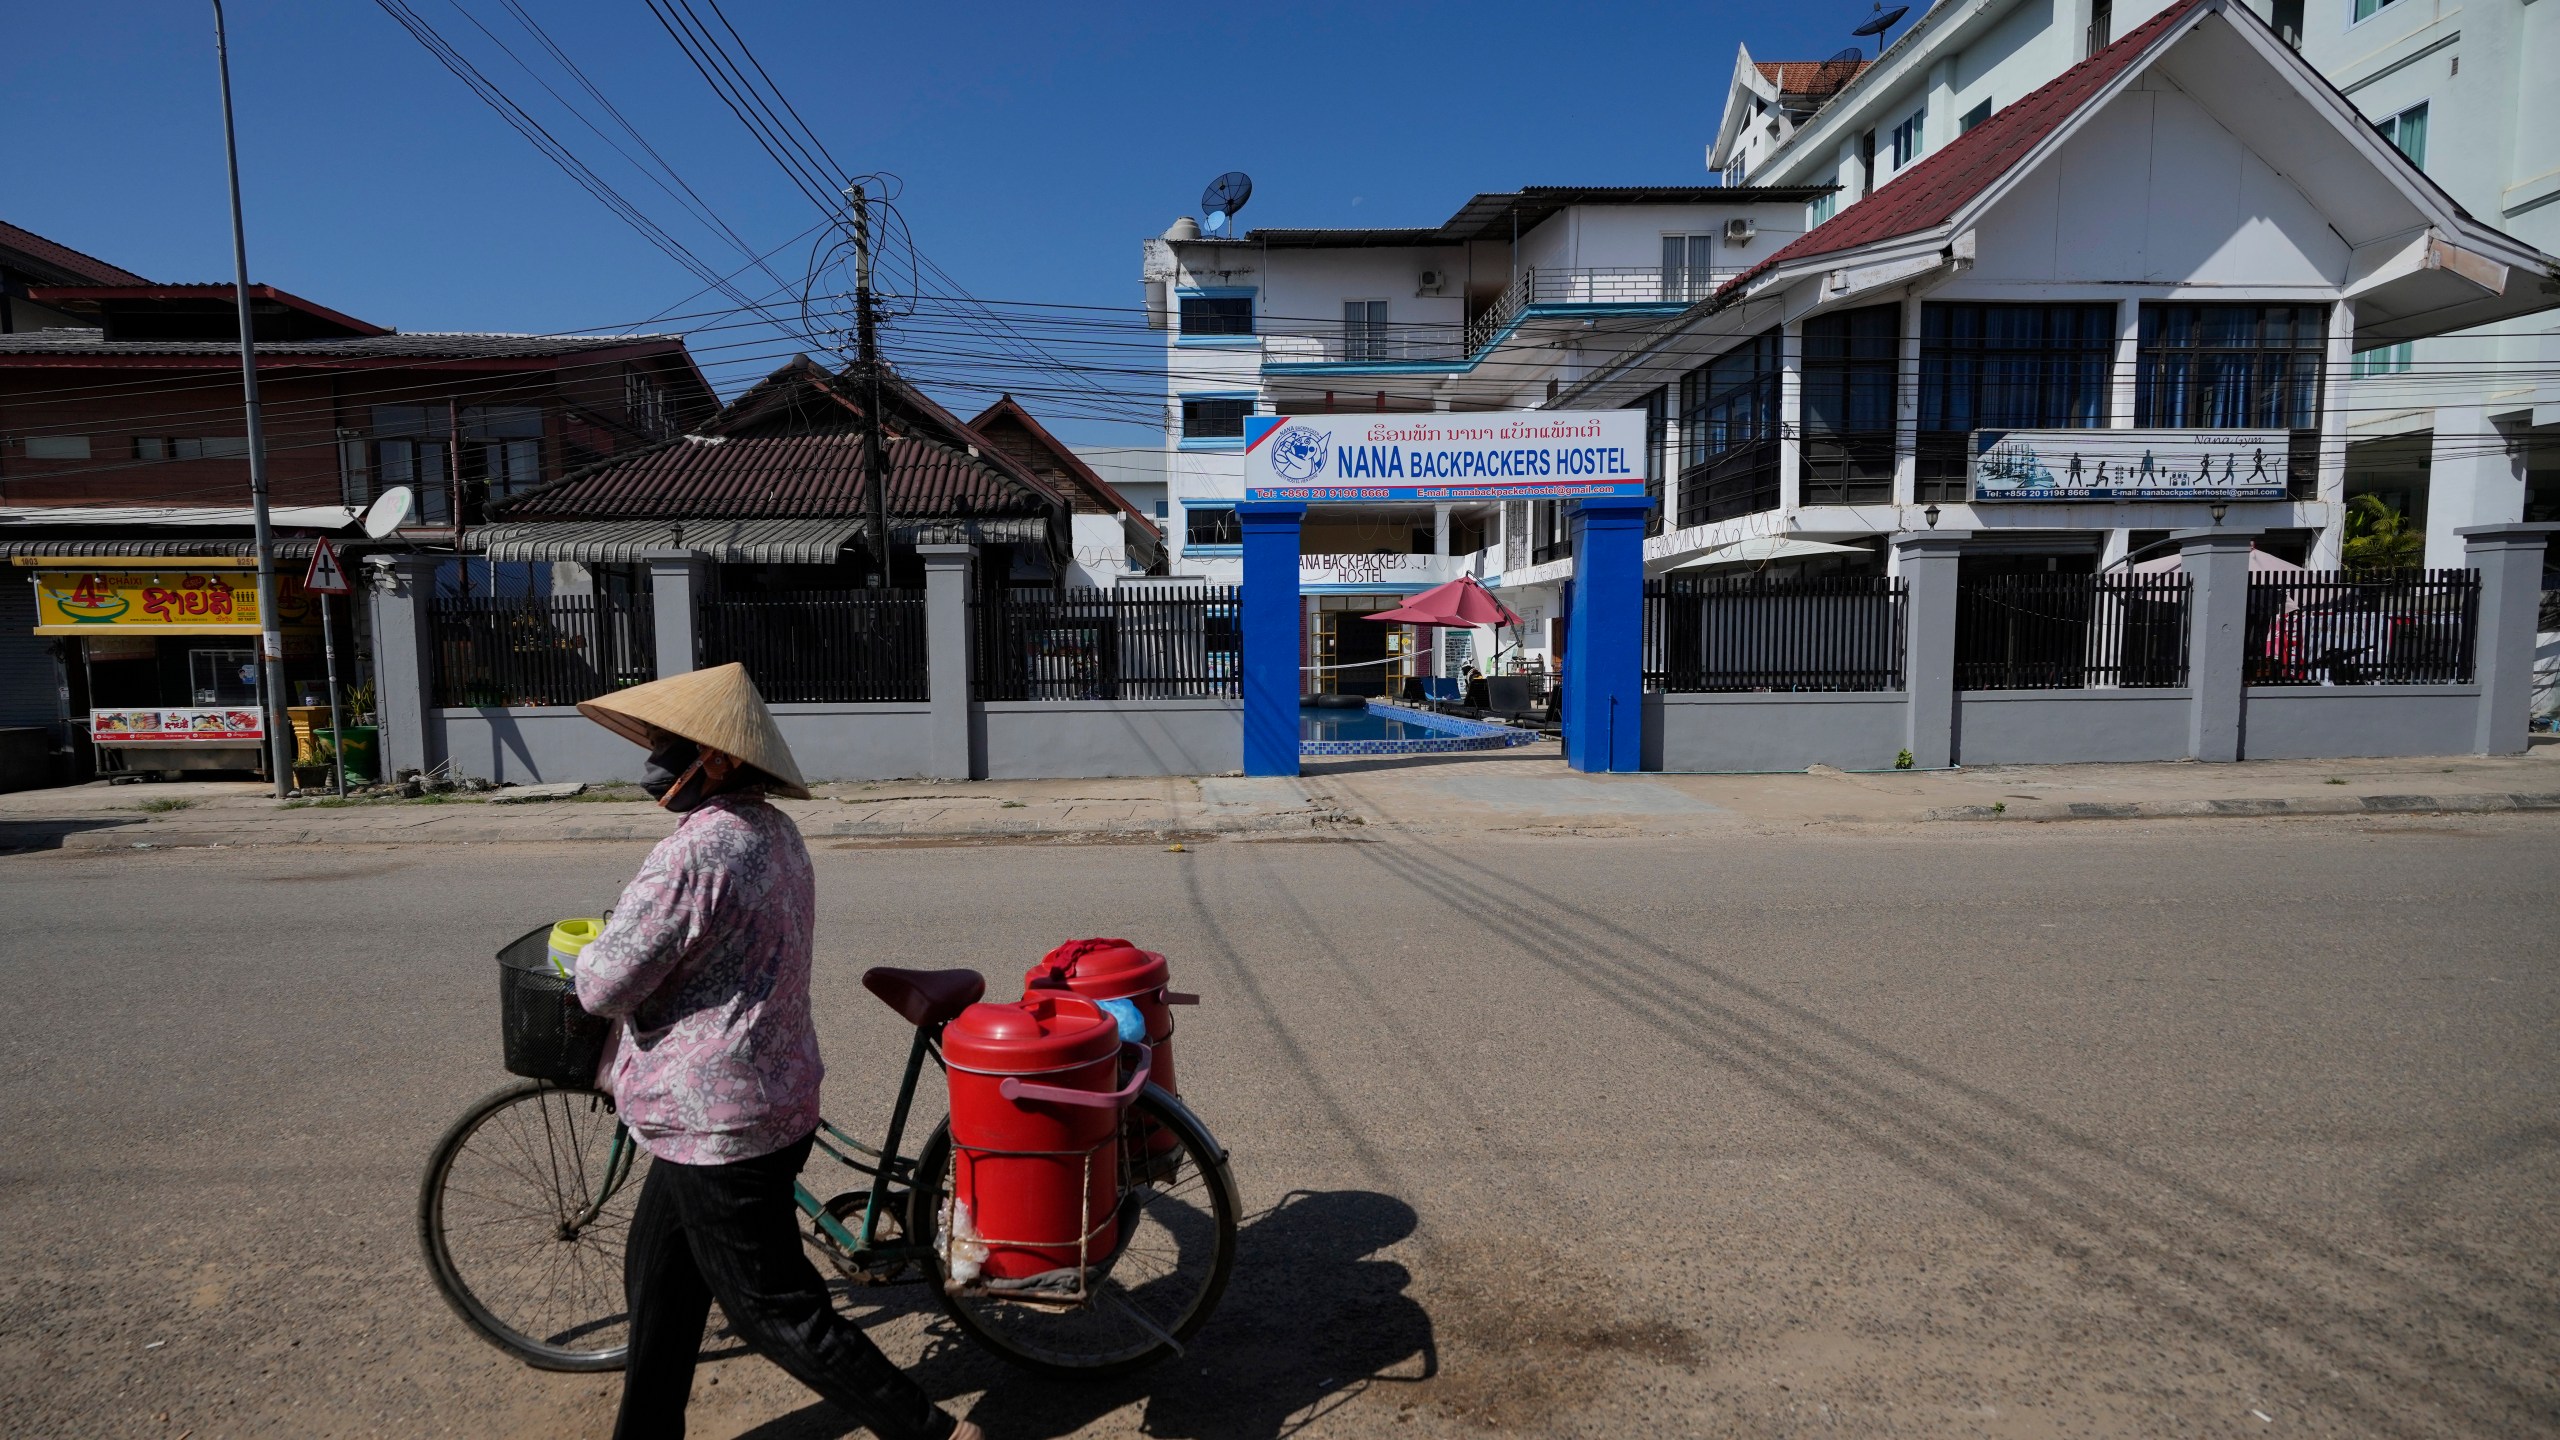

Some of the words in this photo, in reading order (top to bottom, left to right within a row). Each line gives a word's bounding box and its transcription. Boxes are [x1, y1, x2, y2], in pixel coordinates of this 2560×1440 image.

[1447, 428, 1494, 442] ນານາ
[2194, 435, 2233, 444] Nana
[2236, 434, 2265, 448] Gym
[1338, 446, 1404, 478] NANA
[1410, 449, 1551, 478] BACKPACKERS
[1557, 447, 1631, 475] HOSTEL
[1255, 489, 1277, 498] Tel:
[1280, 489, 1309, 498] +856
[1312, 489, 1326, 498] 20
[1329, 489, 1358, 498] 9196
[1361, 489, 1389, 498] 8666
[1417, 488, 1450, 497] E-mail:
[1452, 485, 1614, 497] nanabackpackerhostel@gmail.com
[1985, 490, 2002, 498] Tel:
[2067, 489, 2090, 497] 8666
[2141, 489, 2277, 498] nanabackpackerhostel@gmail.com
[1299, 554, 1320, 569] ANA
[1338, 568, 1387, 583] HOSTEL
